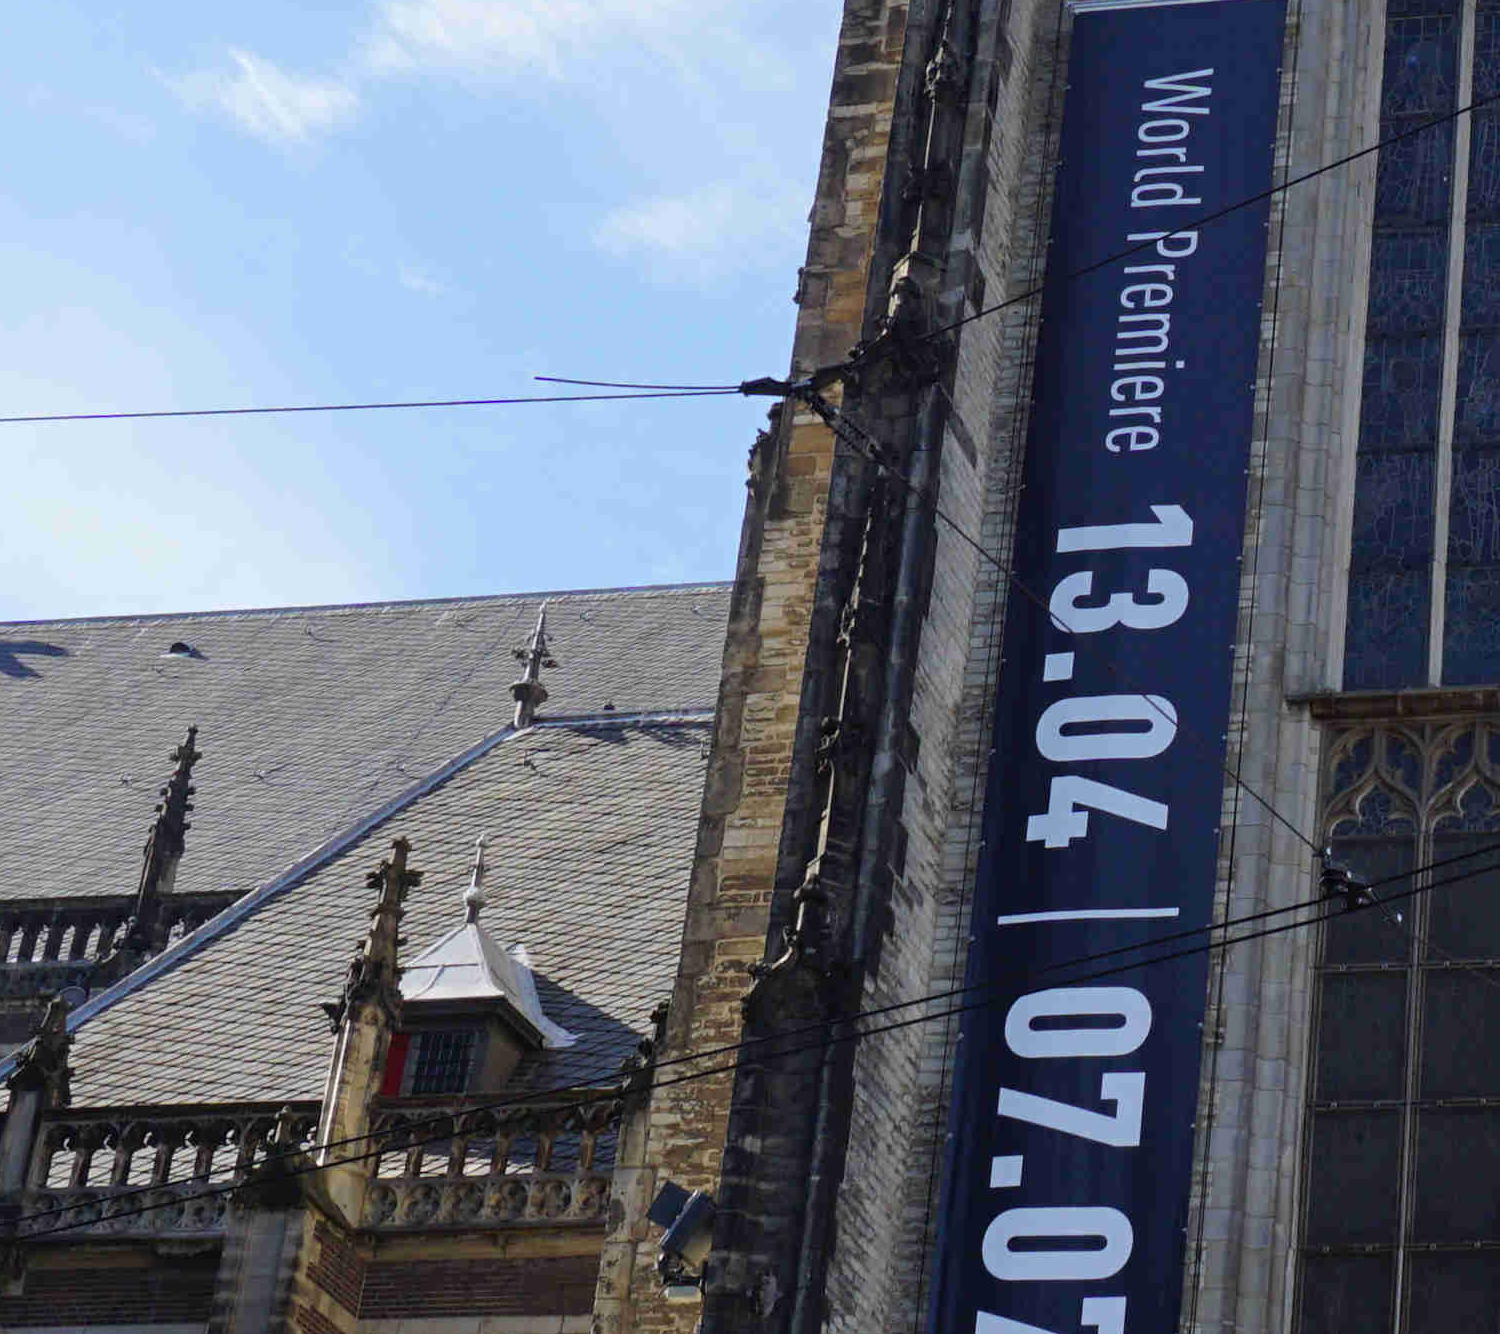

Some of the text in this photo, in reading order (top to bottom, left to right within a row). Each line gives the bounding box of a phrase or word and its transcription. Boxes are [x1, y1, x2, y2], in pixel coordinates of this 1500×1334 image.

[1105, 68, 1214, 453] World Premiere
[1025, 504, 1194, 849] 13.04
